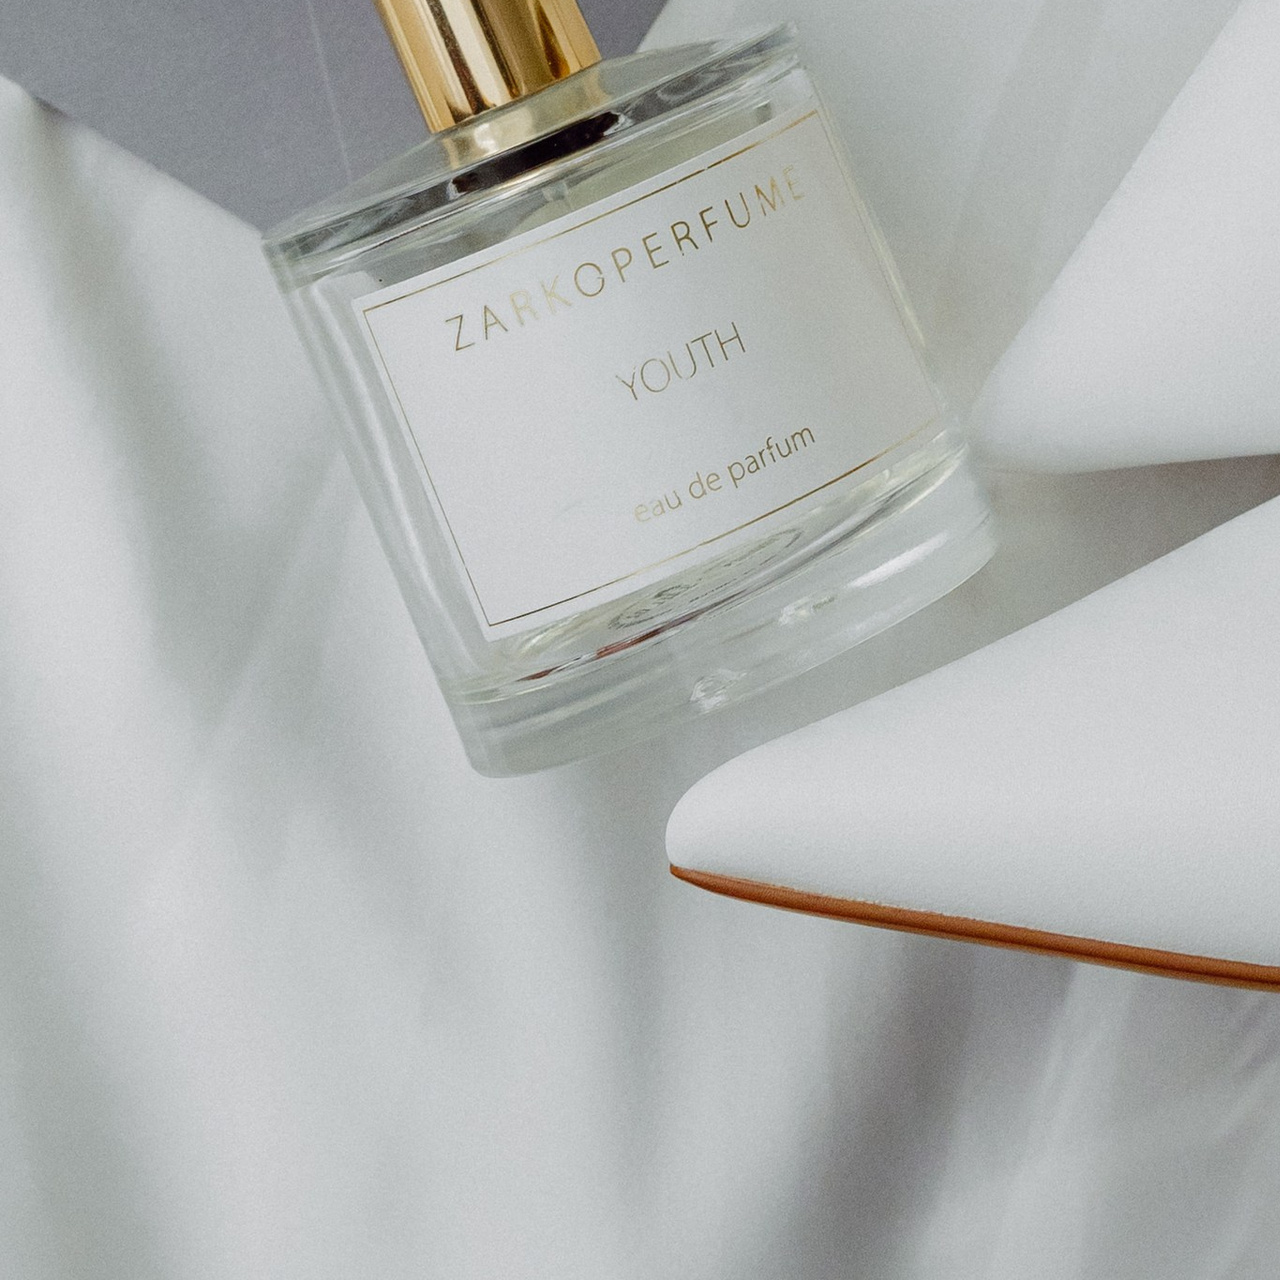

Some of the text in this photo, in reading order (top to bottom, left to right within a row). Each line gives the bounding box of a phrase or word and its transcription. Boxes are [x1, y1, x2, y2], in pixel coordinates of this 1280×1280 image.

[445, 164, 806, 352] ZARKOPERFUME
[615, 322, 747, 401] YOUTH
[634, 425, 816, 523] eau de parfum
